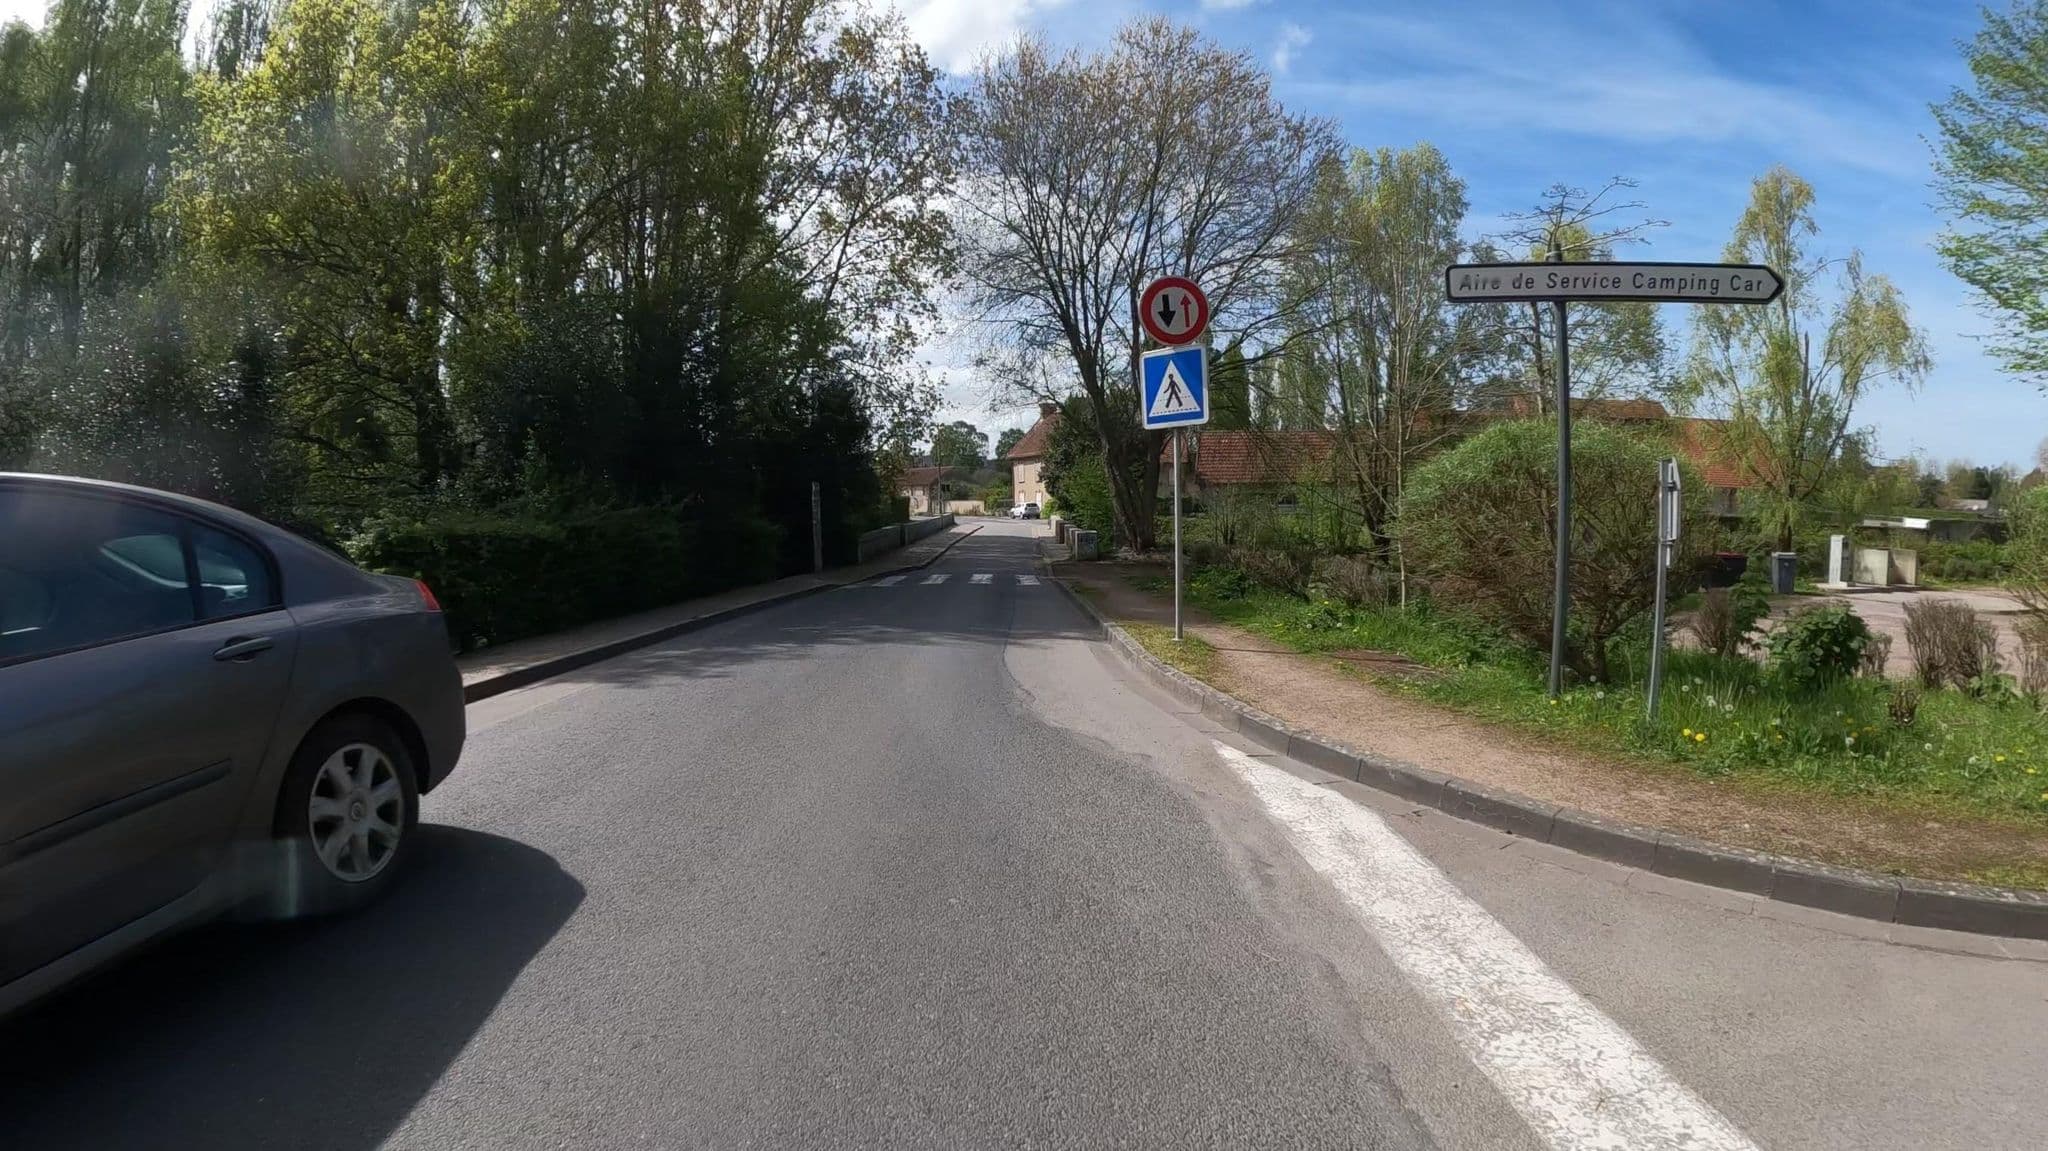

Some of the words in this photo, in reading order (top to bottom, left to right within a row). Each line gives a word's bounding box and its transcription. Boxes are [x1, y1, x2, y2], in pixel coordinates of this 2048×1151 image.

[1459, 273, 1501, 291] Aire
[1512, 272, 1535, 290] de
[1546, 272, 1622, 289] Service
[1632, 272, 1720, 295] Camping
[1730, 274, 1763, 291] Car
